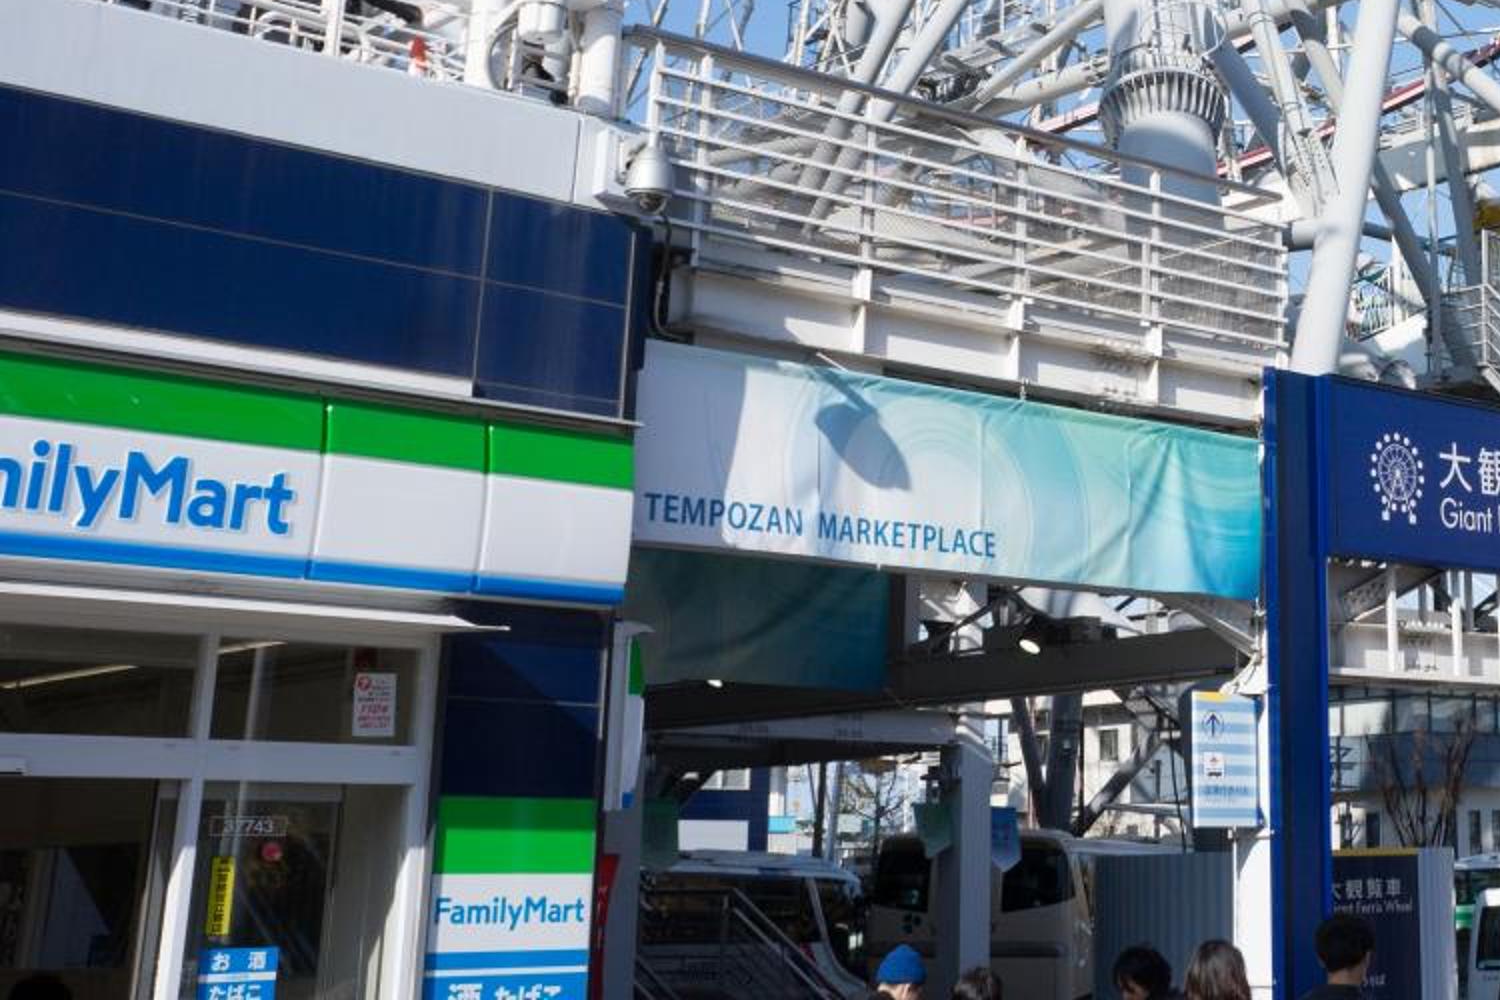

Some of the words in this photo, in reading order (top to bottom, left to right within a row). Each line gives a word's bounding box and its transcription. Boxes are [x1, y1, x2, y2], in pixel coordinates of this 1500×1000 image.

[645, 492, 801, 537] TEMPOZAN
[817, 511, 997, 559] MARKETPLACE
[1440, 498, 1492, 533] Giant
[435, 895, 585, 931] FamilyMart
